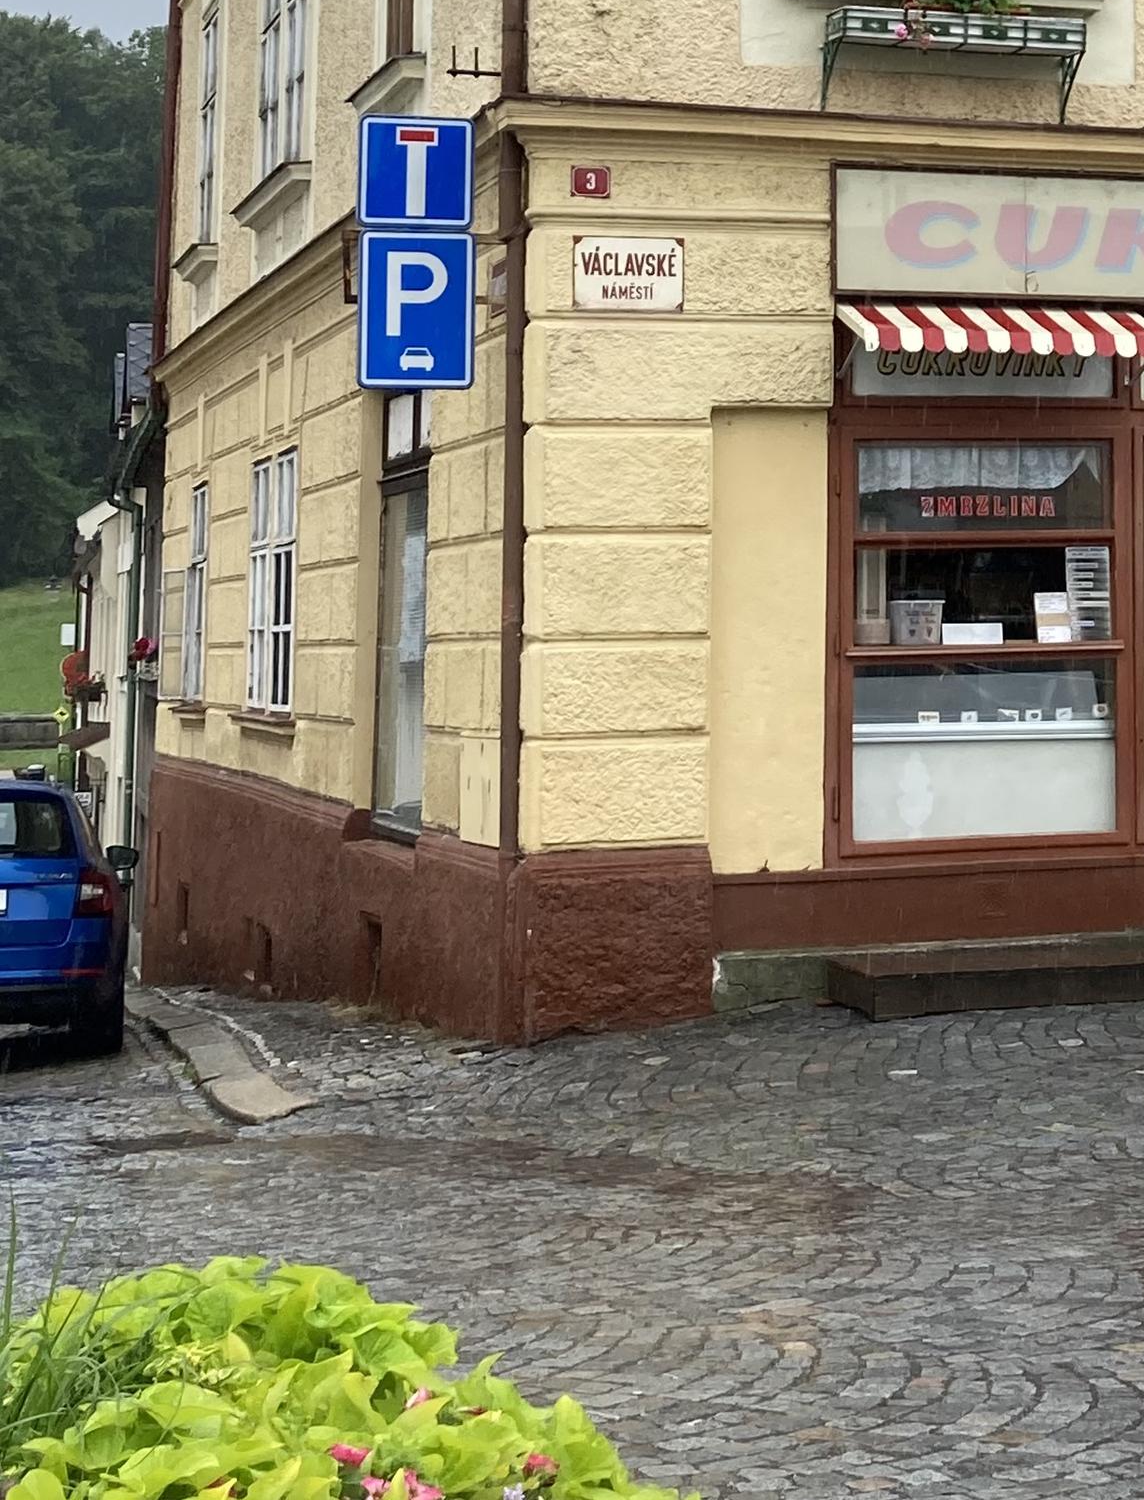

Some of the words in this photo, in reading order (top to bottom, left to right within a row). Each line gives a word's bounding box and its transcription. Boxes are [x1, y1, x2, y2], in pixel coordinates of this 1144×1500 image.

[585, 172, 597, 191] 3
[581, 246, 677, 278] VÁCLAVSKÉ
[385, 251, 449, 337] P
[601, 283, 654, 300] NÁMĚSTÍ
[921, 495, 1056, 517] ZMRZLINA
